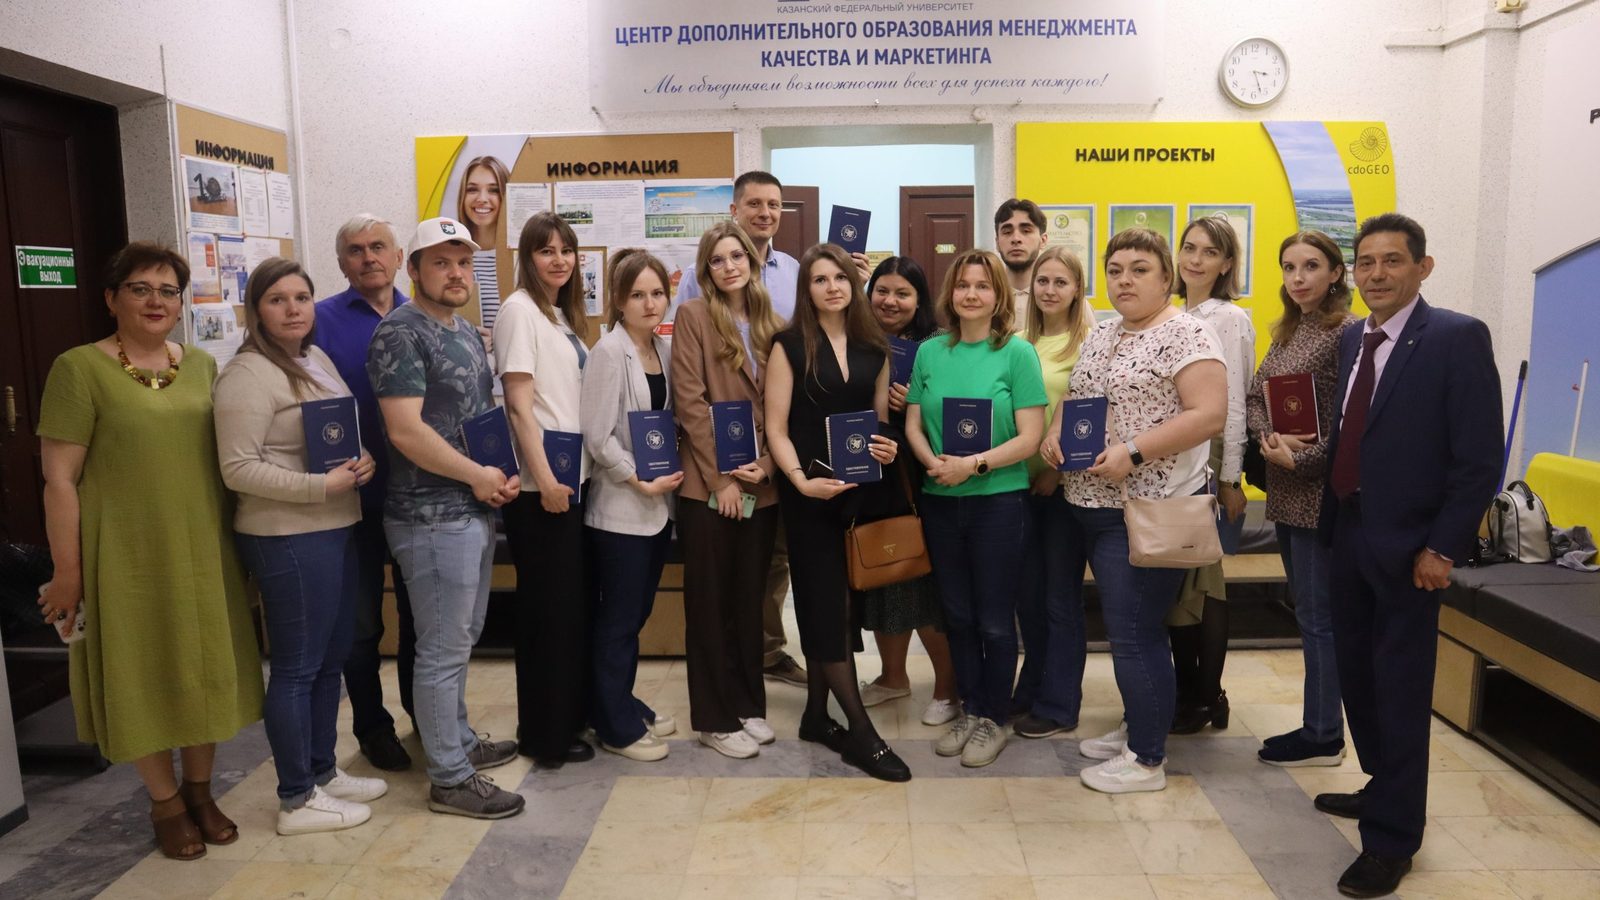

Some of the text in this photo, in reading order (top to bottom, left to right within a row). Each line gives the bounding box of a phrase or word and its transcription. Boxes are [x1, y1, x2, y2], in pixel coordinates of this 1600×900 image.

[777, 2, 974, 14] КАЗАНСКИЙ ФЕДЕРАЛЬНЫЙ УНИВЕРСИТЕТ
[615, 18, 1137, 46] ЦЕНТР ДОПОЛНИТЕЛЬНОГО ОБРАЗОВАНИЯ МЕНЕДЖМЕНТА
[761, 47, 992, 67] КАЧЕСТВА И МАРКЕТИНГА
[644, 71, 1109, 99] Мы объединяем возможности всех для успеха каждого!
[195, 139, 274, 170] ИНФОРМАЦИЯ
[1075, 148, 1215, 163] НАШИ ПРОЕКТЫ
[547, 160, 679, 176] ИНФОРМАЦИЯ
[1347, 164, 1390, 175] cdoGEO
